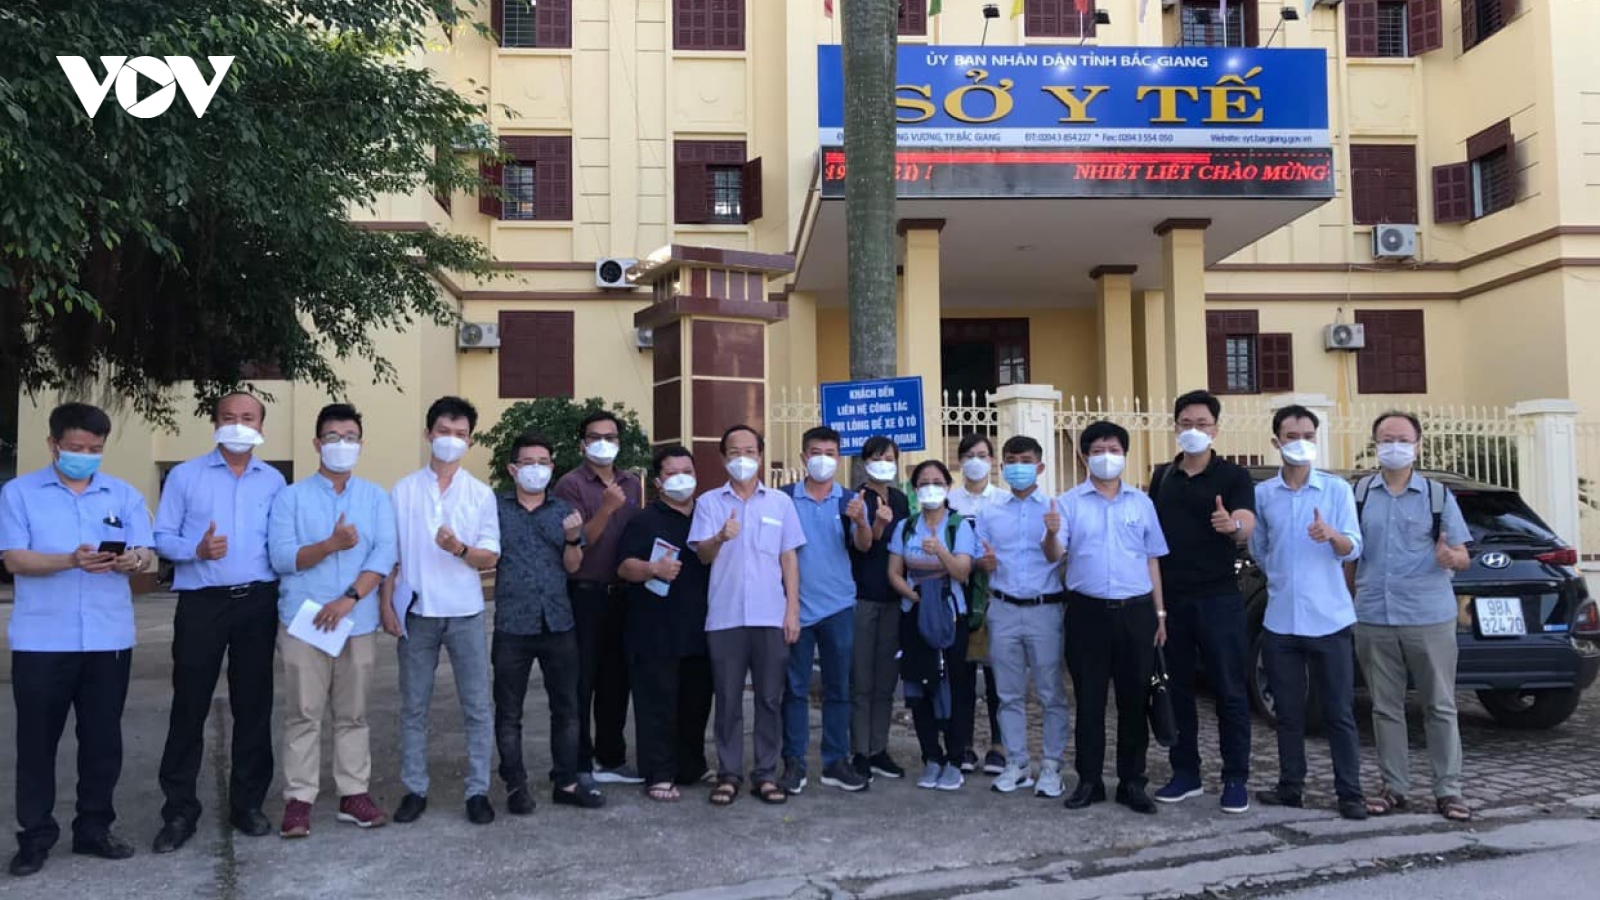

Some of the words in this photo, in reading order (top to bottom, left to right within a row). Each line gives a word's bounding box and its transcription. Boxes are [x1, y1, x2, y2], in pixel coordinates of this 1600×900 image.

[926, 51, 949, 66] ỦY
[954, 54, 988, 66] BAN
[991, 52, 1038, 66] NHÂN
[1042, 52, 1078, 67] DÂN
[1080, 51, 1118, 67] TỈNH
[1120, 50, 1153, 67] BẮC
[1157, 55, 1209, 68] GIANG
[896, 68, 1015, 124] SỞ
[1041, 86, 1110, 123] Y
[1136, 66, 1265, 124] TẾ
[973, 133, 1000, 141] GIANG
[1198, 160, 1258, 180] CHÀO
[1487, 600, 1512, 616] 98A
